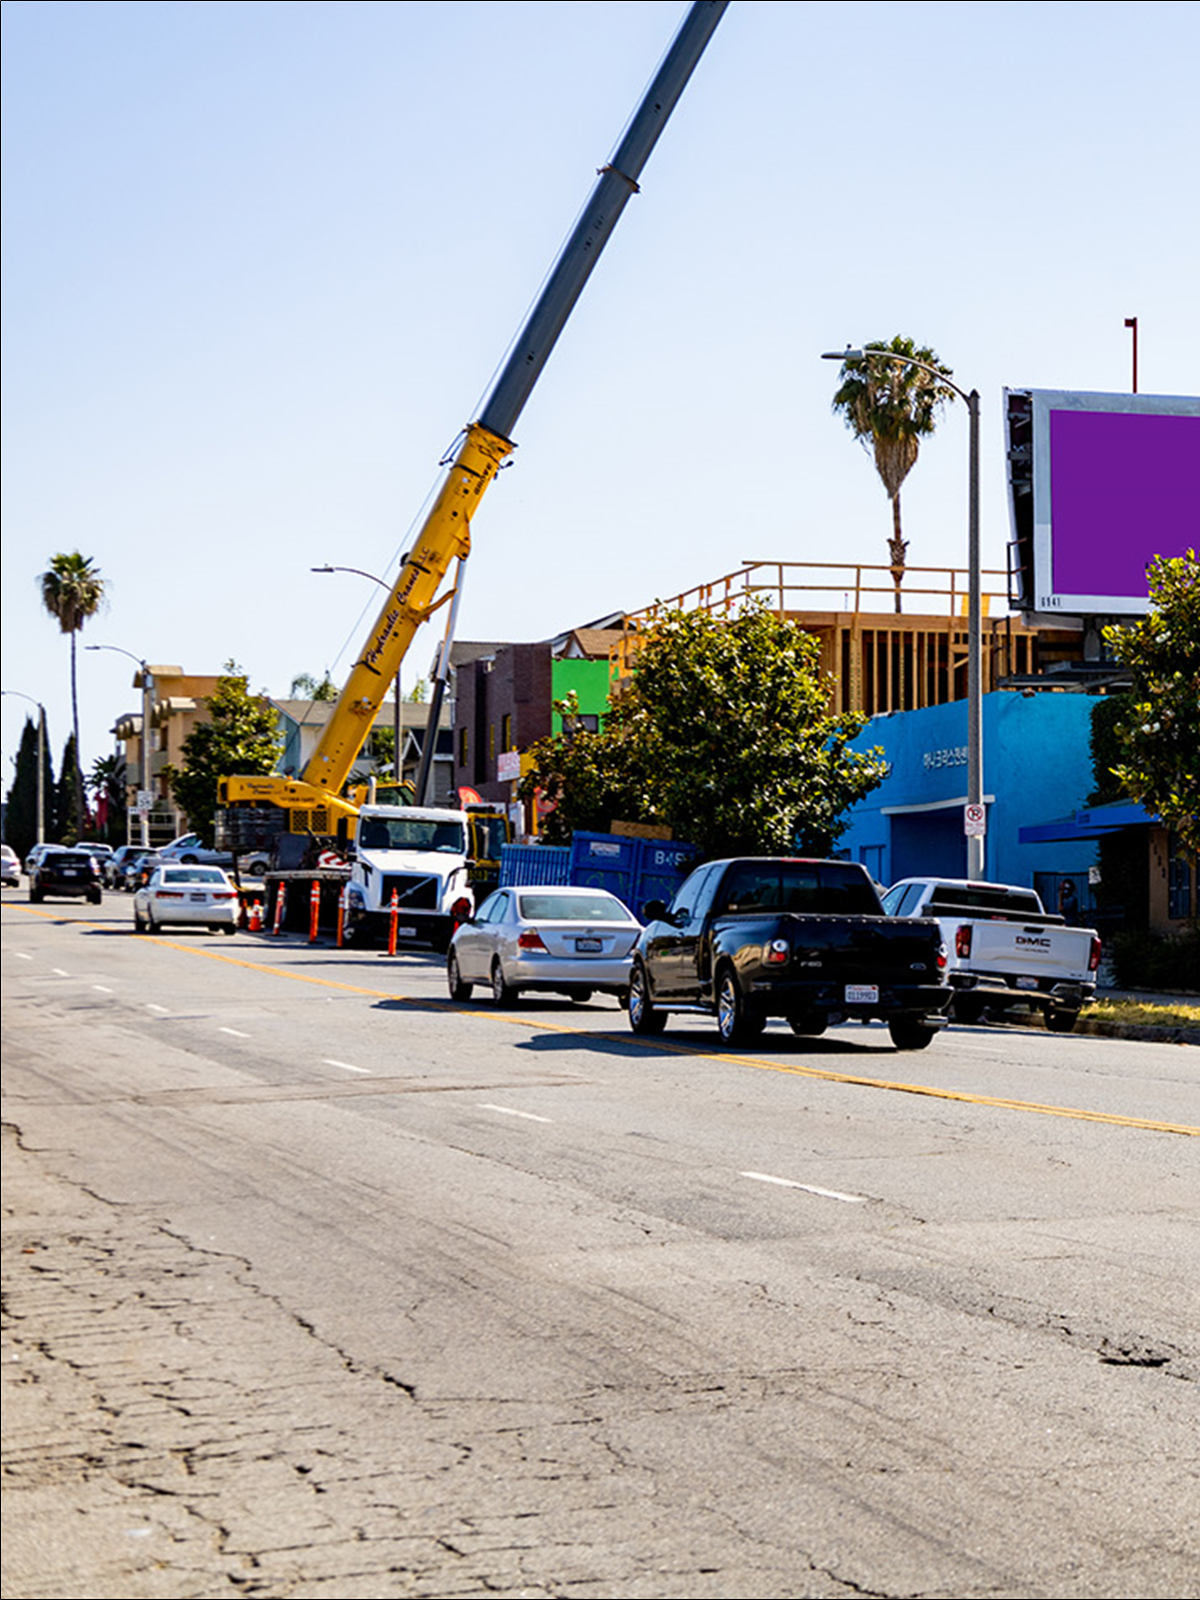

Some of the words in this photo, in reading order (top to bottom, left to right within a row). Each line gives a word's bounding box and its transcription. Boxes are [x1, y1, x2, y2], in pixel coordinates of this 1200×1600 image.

[365, 609, 399, 663] Hydraulic
[396, 568, 420, 605] Cranes
[1015, 936, 1051, 947] GMC
